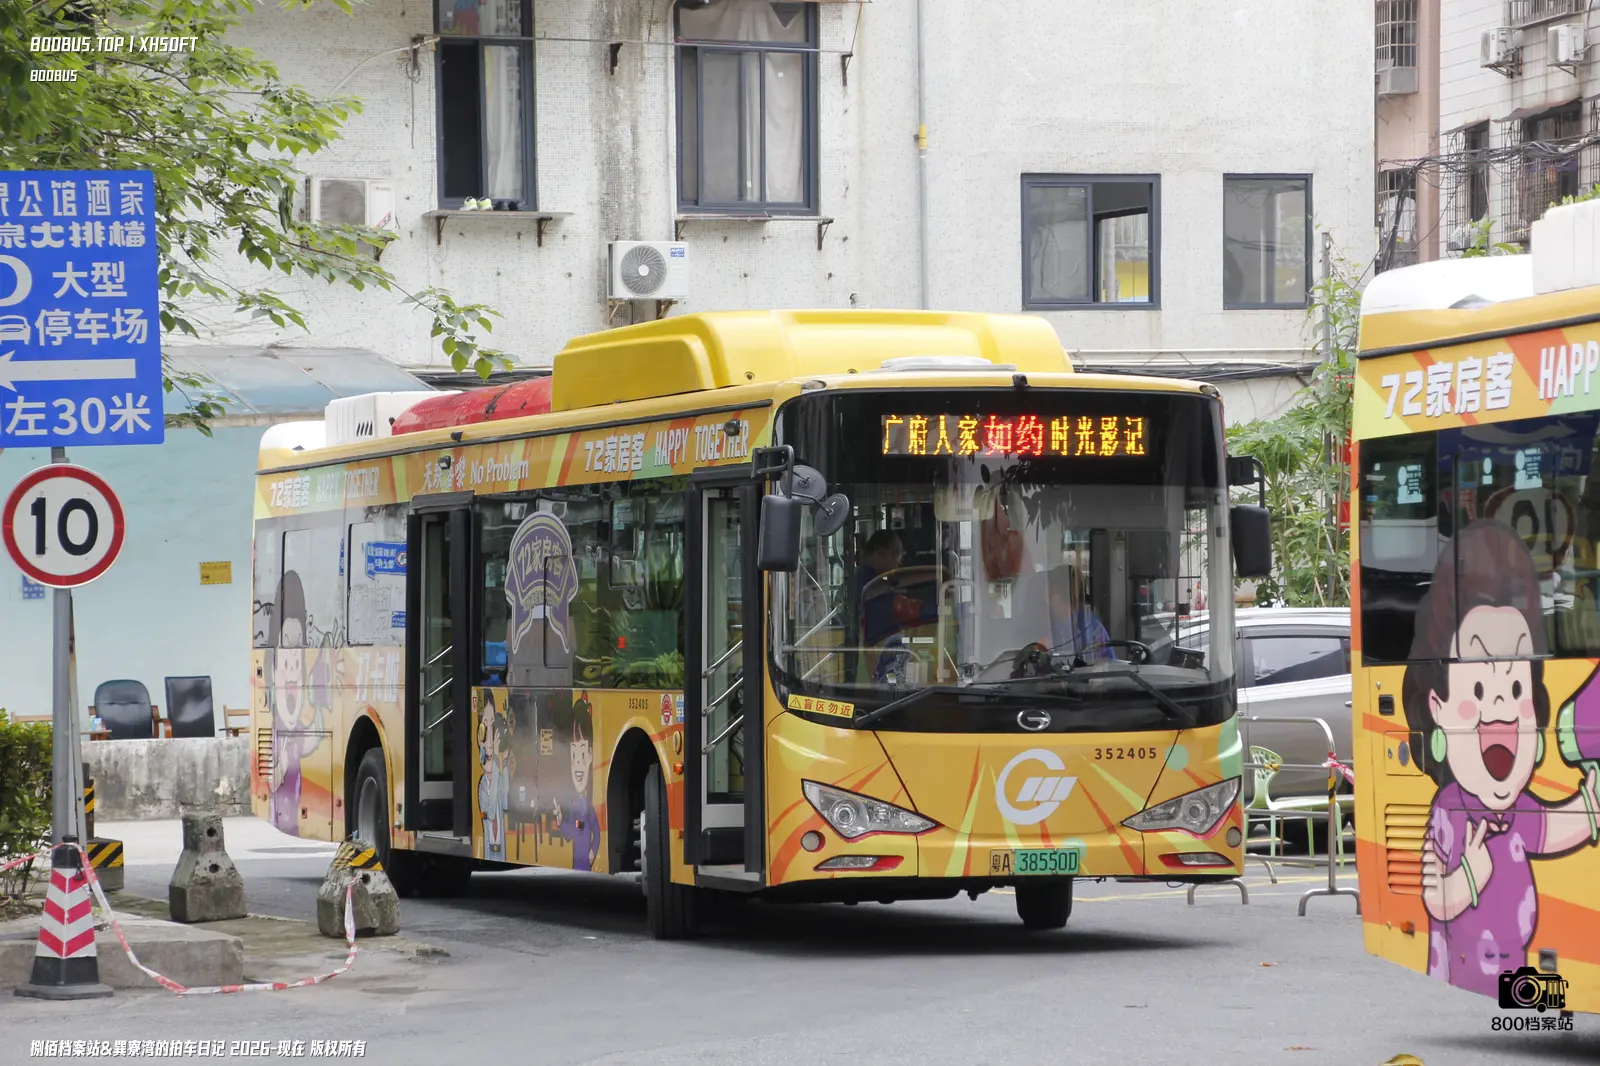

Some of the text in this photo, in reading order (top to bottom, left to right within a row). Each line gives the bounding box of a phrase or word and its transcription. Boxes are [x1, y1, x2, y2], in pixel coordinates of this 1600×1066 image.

[52, 260, 128, 299] 大型
[35, 308, 149, 347] 停车场
[1381, 340, 1600, 419] 72家房客 HAPP
[0, 394, 152, 438] 左30米
[470, 460, 485, 485] No
[486, 452, 529, 483] Problem
[585, 432, 645, 473] 72家房客
[654, 427, 690, 467] HAPPY
[30, 496, 99, 557] 10
[628, 697, 649, 710] 352405
[804, 698, 852, 717] 盲区勿近
[1094, 747, 1157, 761] 352405
